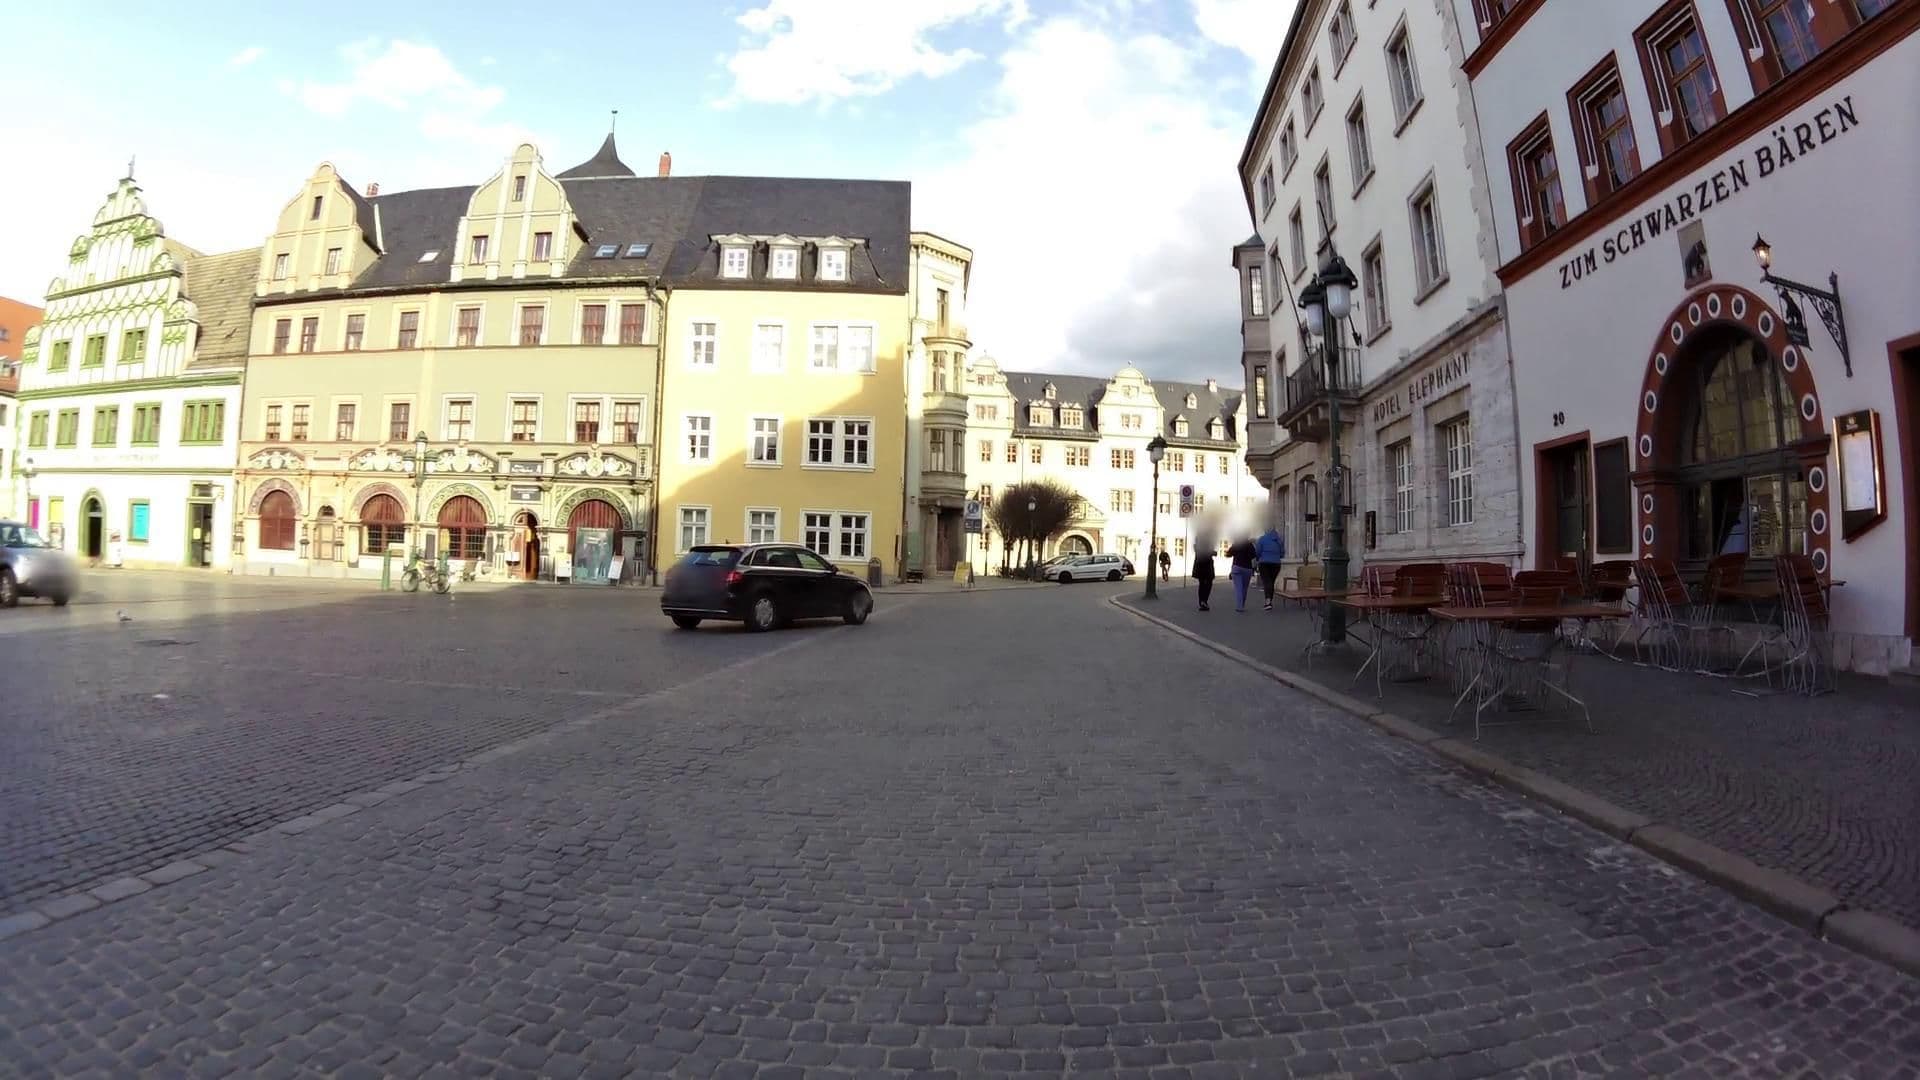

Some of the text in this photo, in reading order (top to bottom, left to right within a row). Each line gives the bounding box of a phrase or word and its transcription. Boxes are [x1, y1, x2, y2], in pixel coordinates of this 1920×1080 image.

[1558, 95, 1860, 290] ZUM SCHWARZEN BÄREN
[1373, 351, 1470, 423] HOTEL ELEPHANT
[1552, 411, 1566, 427] 20
